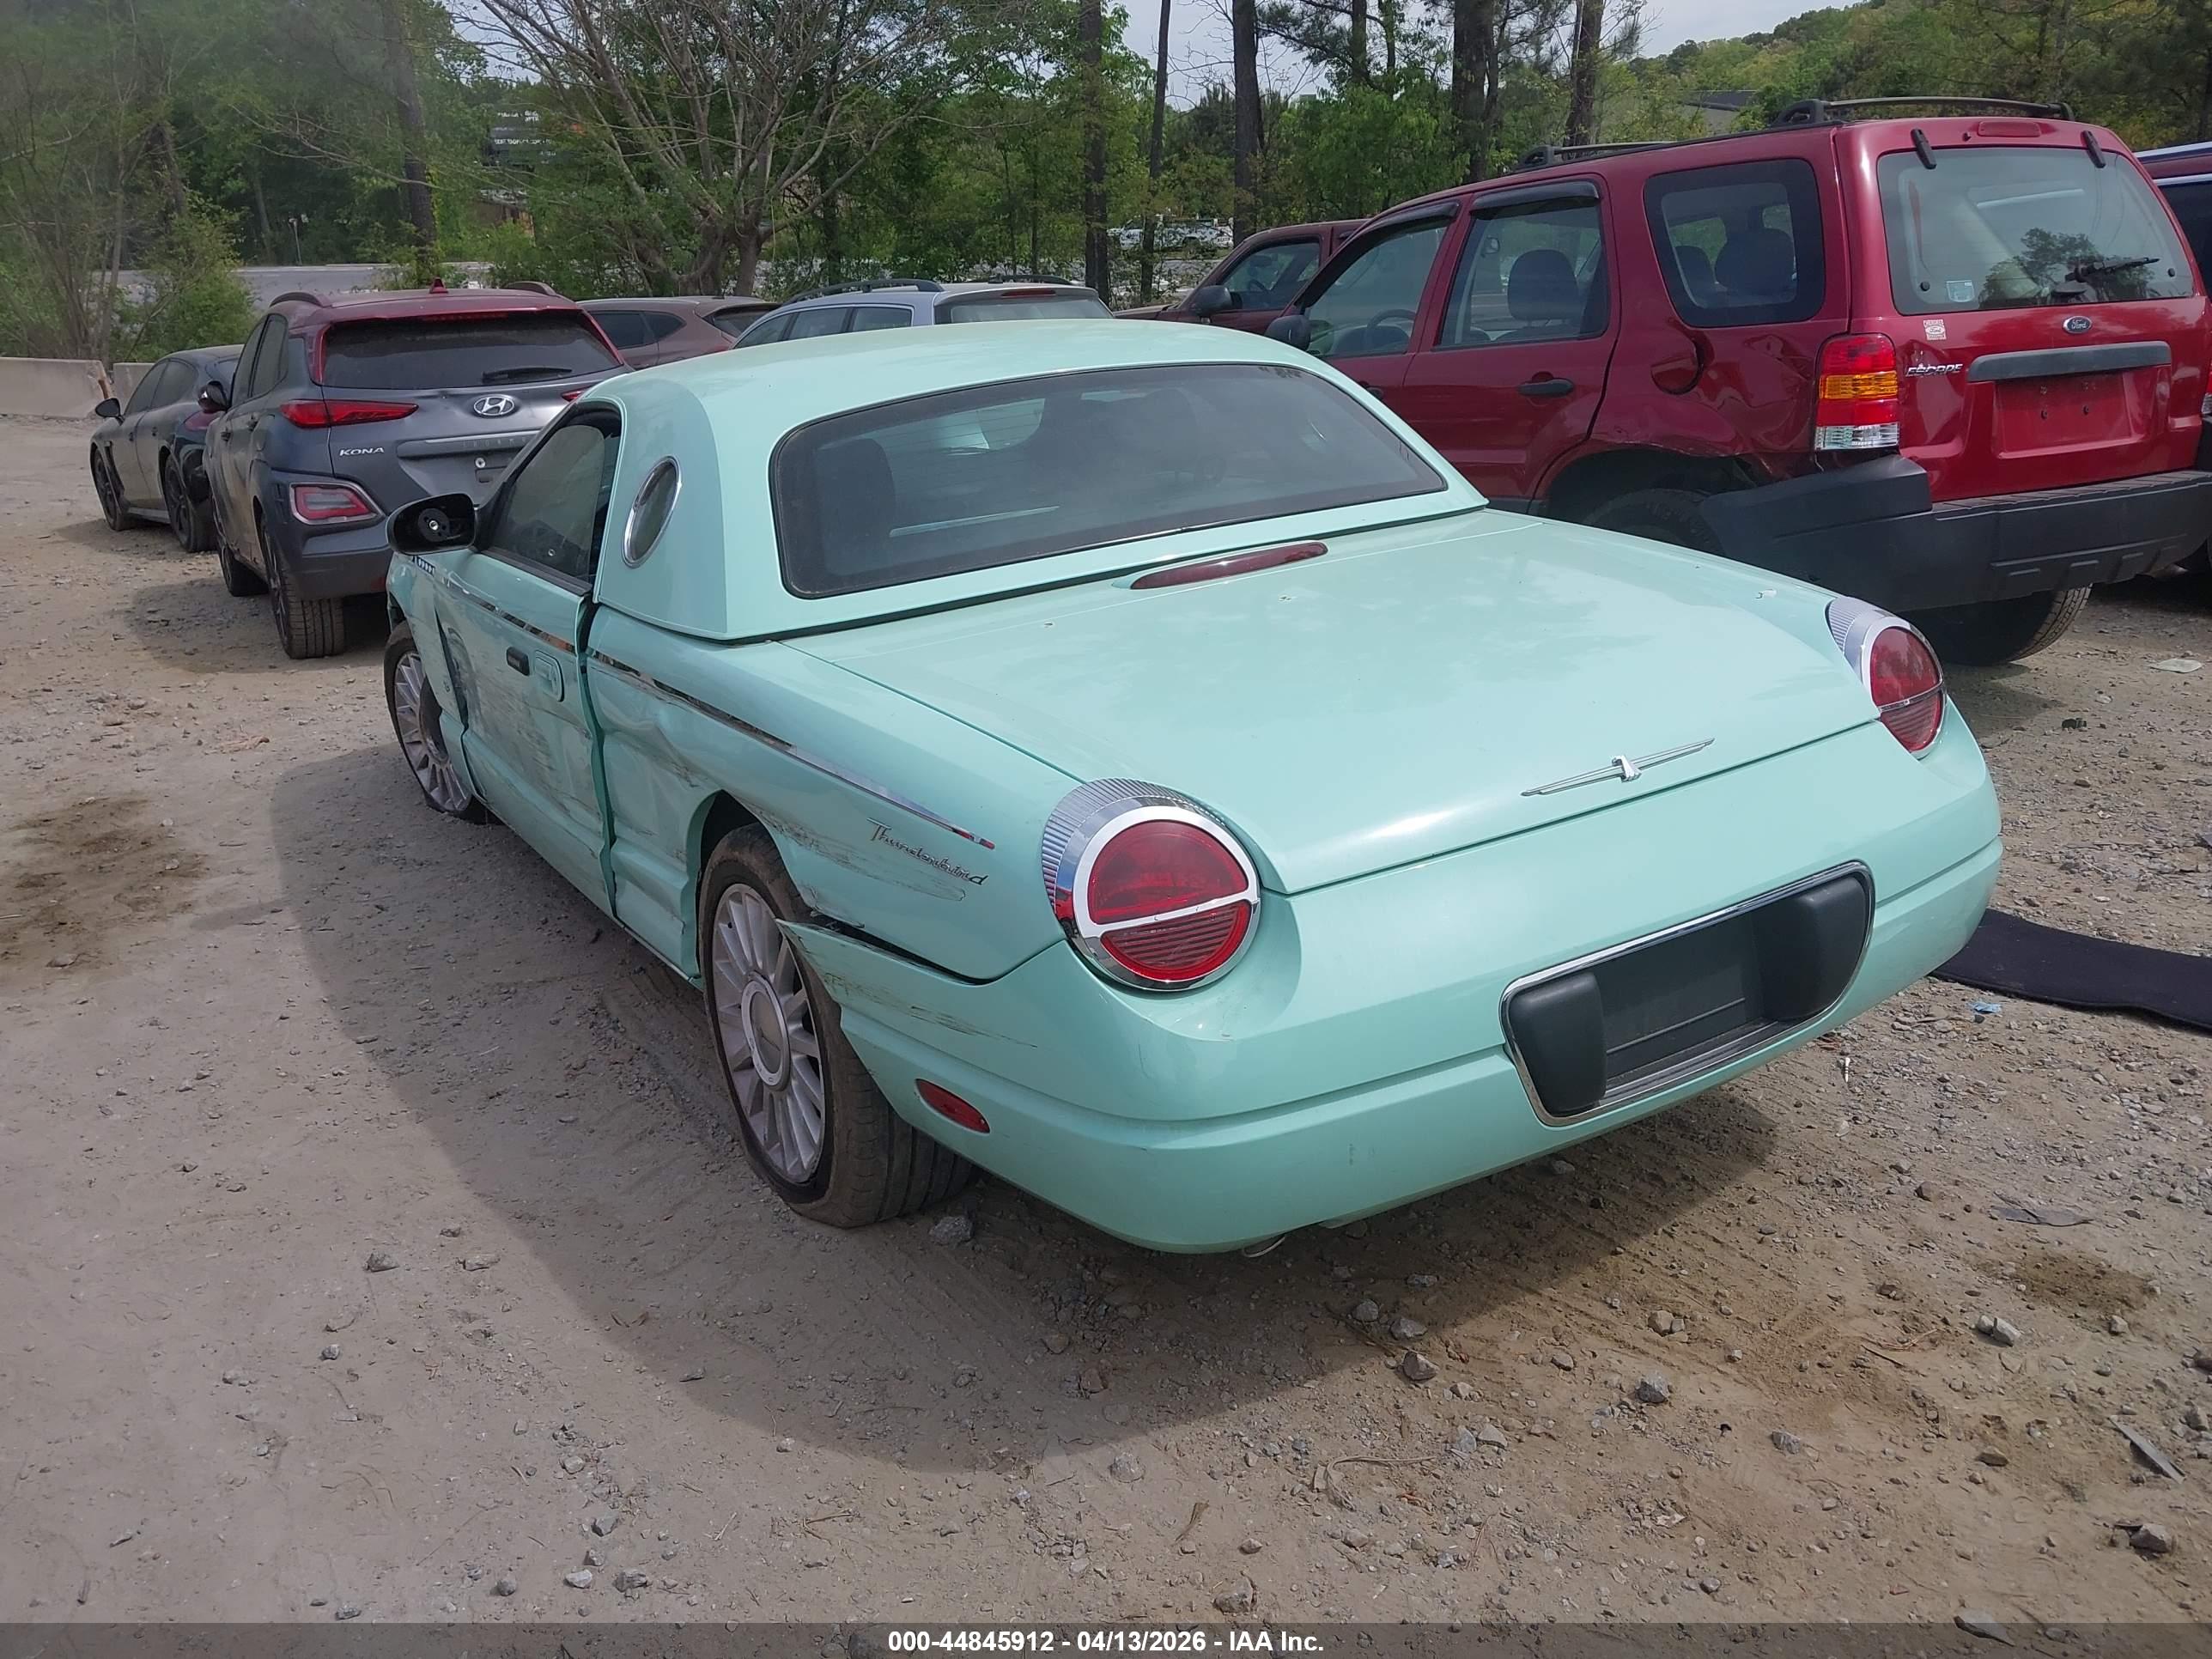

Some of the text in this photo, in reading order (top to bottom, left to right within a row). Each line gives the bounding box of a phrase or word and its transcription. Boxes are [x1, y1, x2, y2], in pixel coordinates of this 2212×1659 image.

[2071, 318, 2087, 330] Ford
[1905, 363, 1964, 377] ESCAPE
[339, 446, 385, 457] KONA
[866, 817, 989, 886] Thunderbird
